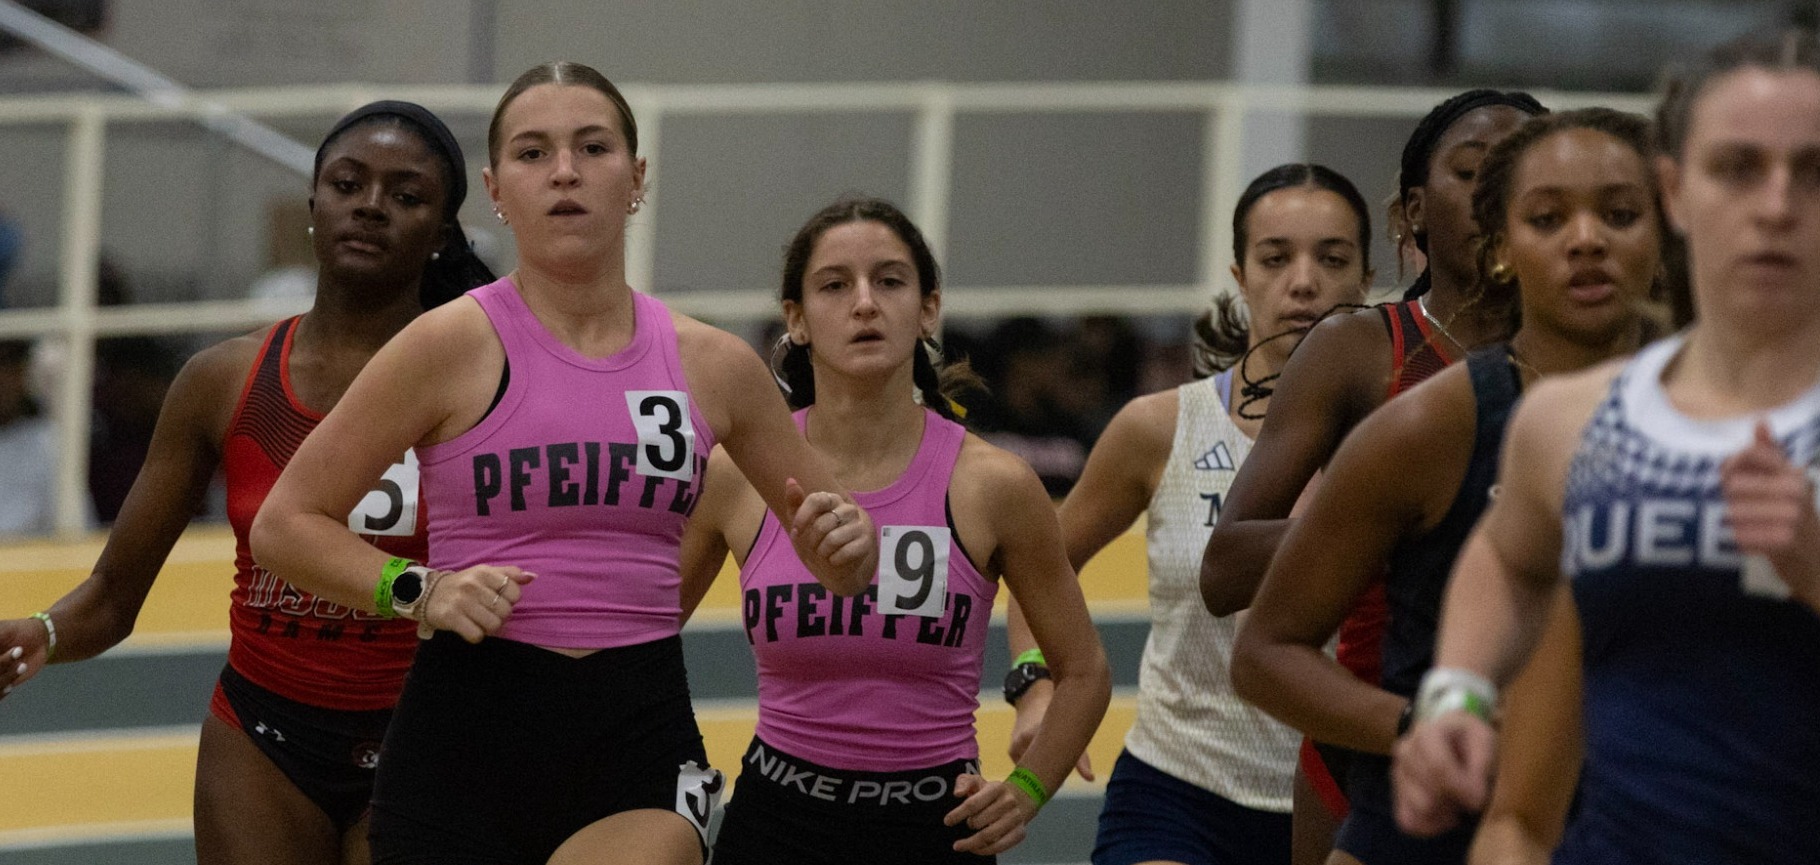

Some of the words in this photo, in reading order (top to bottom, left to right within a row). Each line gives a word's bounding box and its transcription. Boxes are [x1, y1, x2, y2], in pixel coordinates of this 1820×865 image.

[639, 395, 687, 473] 3
[894, 529, 936, 611] 9
[749, 744, 843, 802] NIKE
[847, 775, 948, 806] PRO
